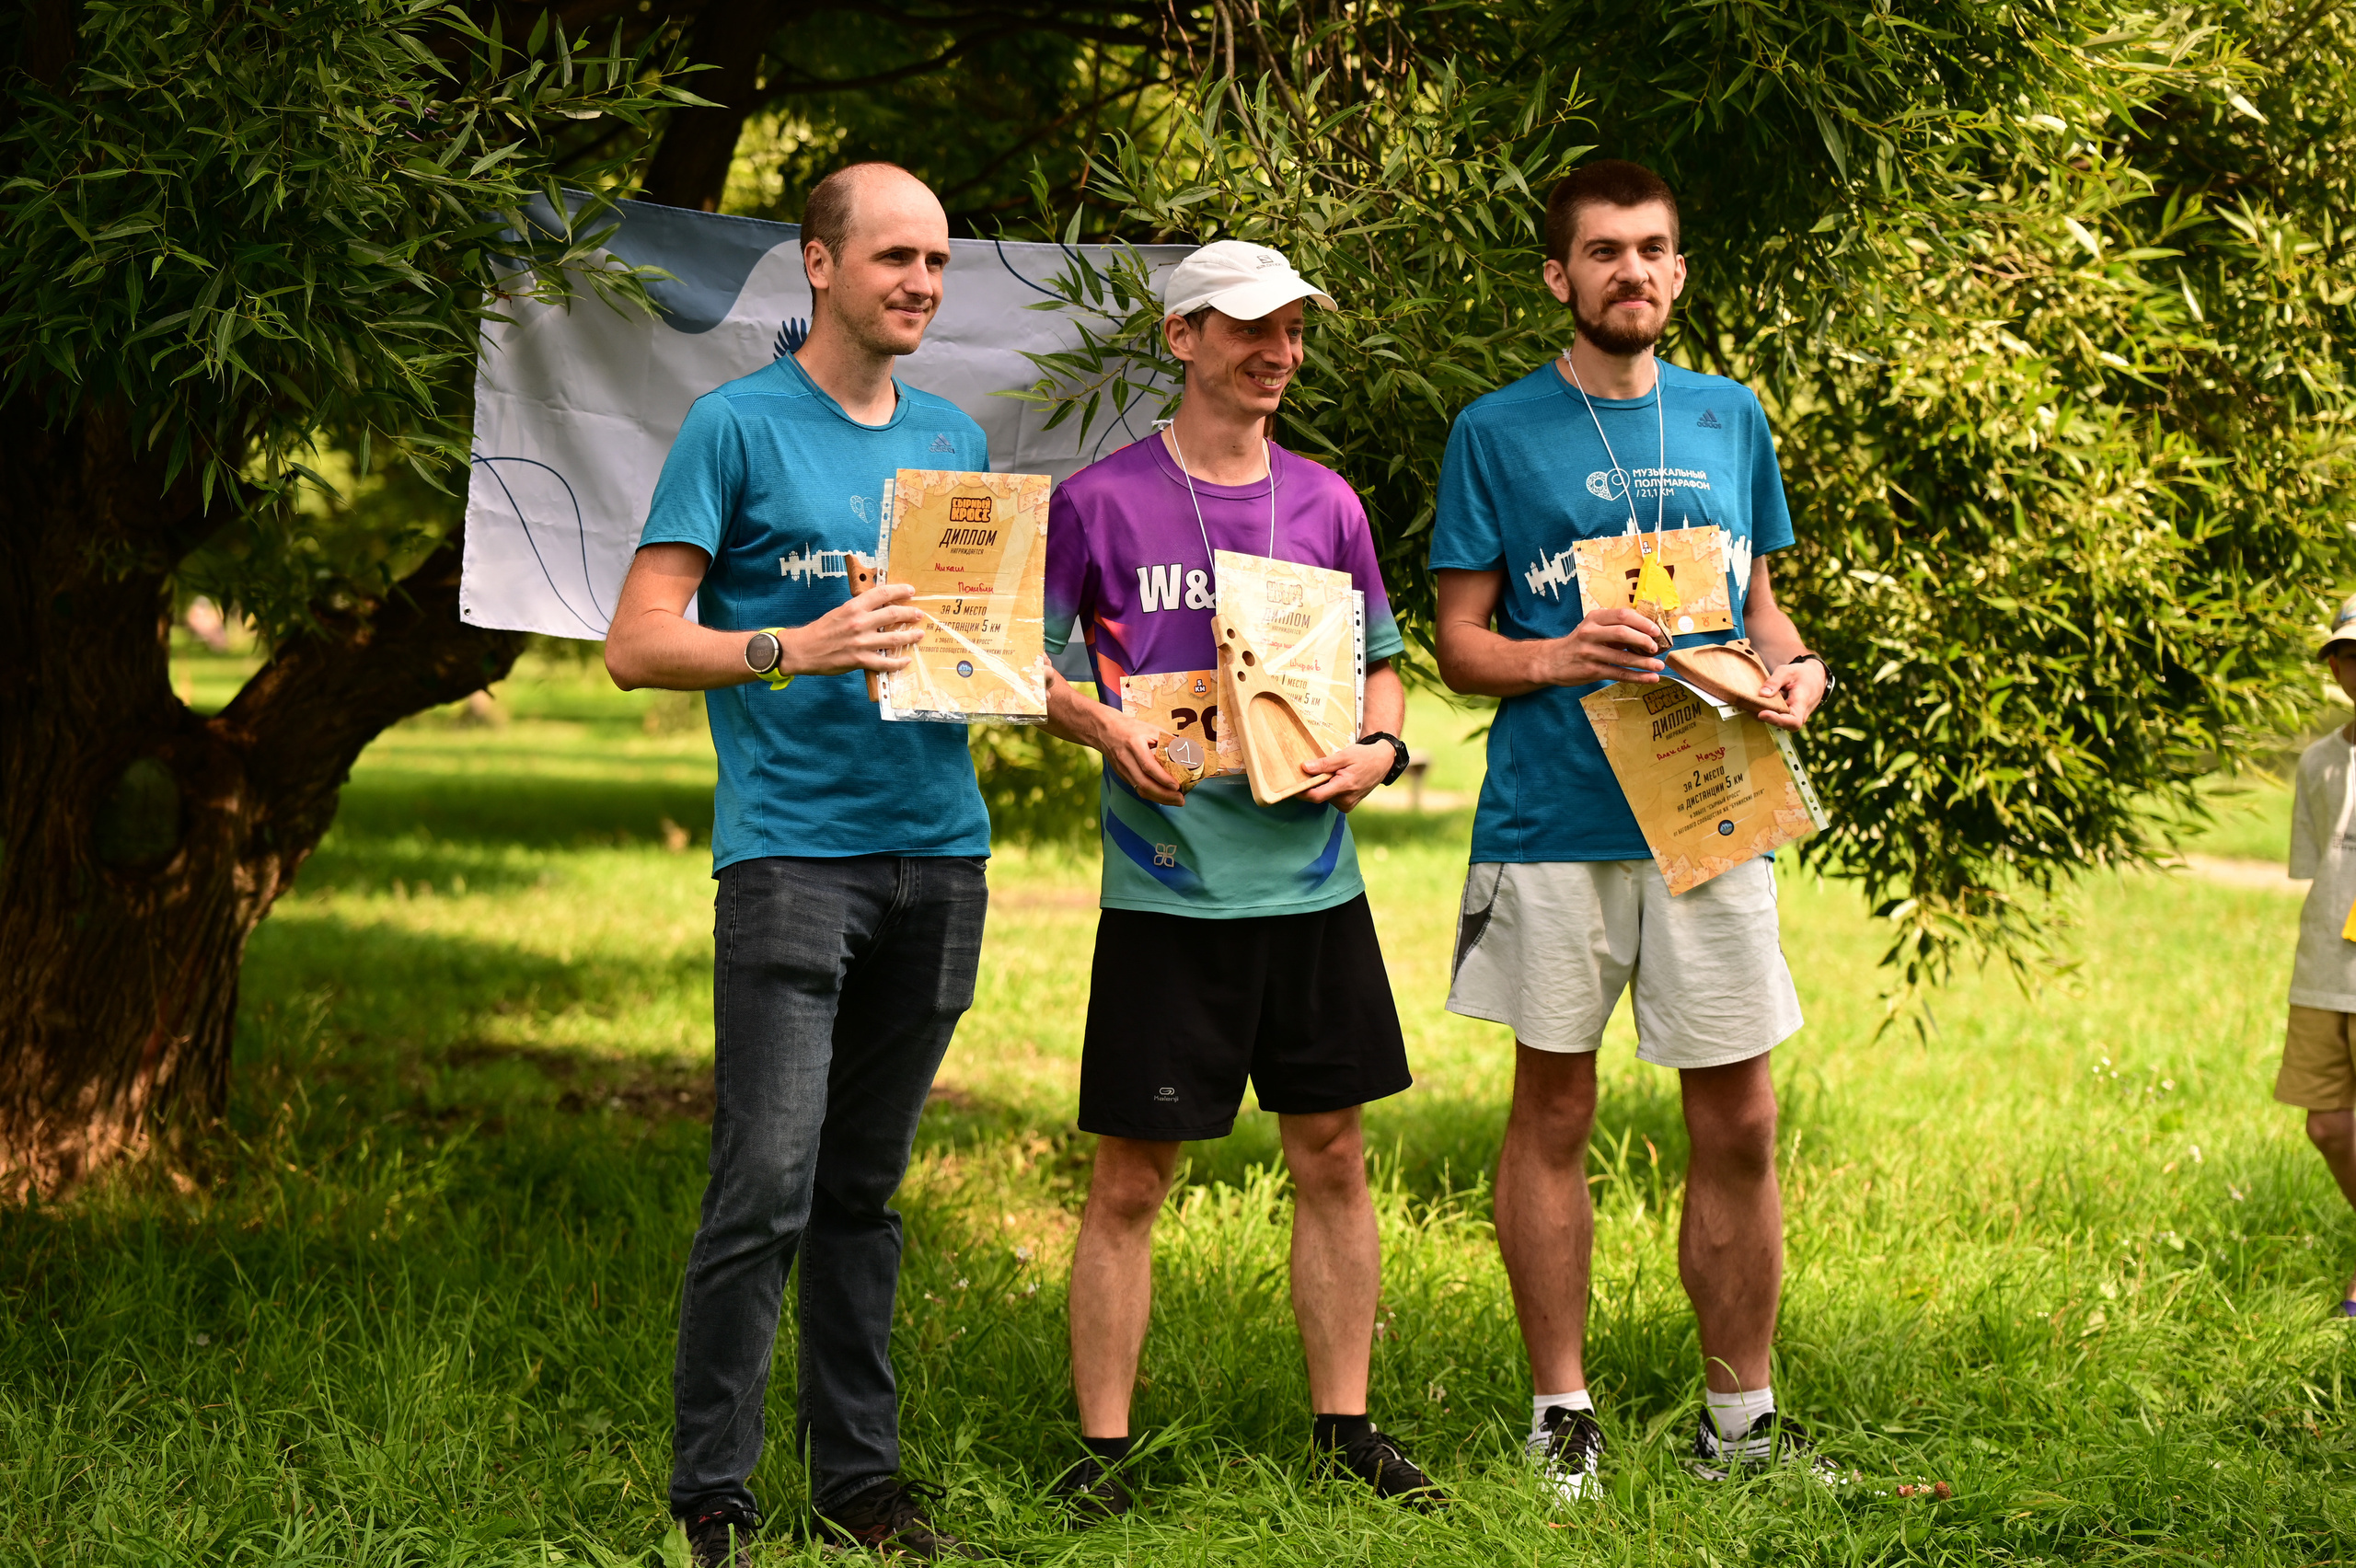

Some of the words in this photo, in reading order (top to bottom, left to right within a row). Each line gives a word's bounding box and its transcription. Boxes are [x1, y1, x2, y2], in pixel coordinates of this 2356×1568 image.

[1633, 467, 1707, 480] МУЗЫКАЛЬНЫЙ
[1634, 478, 1711, 490] ПОЛУМАРАФОН
[952, 497, 992, 509] СЫРНЫЙ
[950, 507, 991, 523] КРОСС
[939, 528, 998, 548] ДИПЛОМ
[935, 563, 964, 572] Михаил
[1136, 563, 1216, 614] W&
[941, 605, 951, 615] ЗА
[953, 598, 963, 615] 3
[963, 605, 987, 616] МЕСТО
[934, 621, 980, 634] ДСТАНЦИИ
[981, 619, 988, 632] 5
[989, 623, 1001, 632] КМ
[1287, 678, 1307, 689] МЕСТО
[1303, 692, 1311, 704] 5
[1646, 691, 1688, 715] КРОСС
[1652, 701, 1702, 742] ДИПЛОМ
[1666, 721, 1696, 740] НАГРАЖДАЕТСЯ
[1683, 781, 1692, 792] ЗА
[1693, 770, 1702, 788] 2
[1703, 766, 1725, 783] МЕСТО
[1686, 782, 1725, 811] ДИСТАНЦИИ
[1726, 775, 1732, 789] 5
[1734, 773, 1743, 785] КМ
